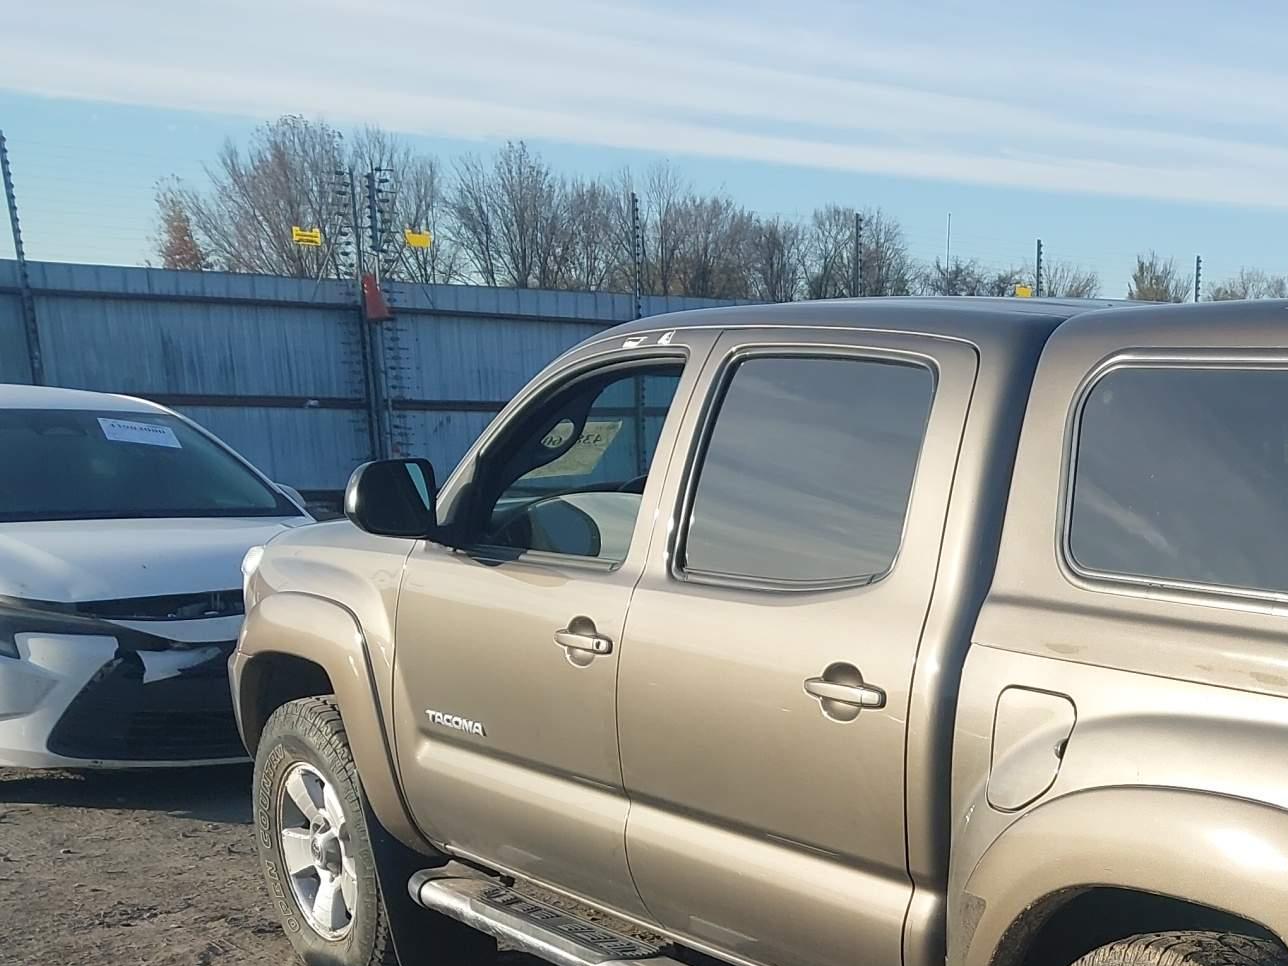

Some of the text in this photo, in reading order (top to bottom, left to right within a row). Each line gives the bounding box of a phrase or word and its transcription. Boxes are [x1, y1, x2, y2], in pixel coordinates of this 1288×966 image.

[424, 709, 486, 737] TACOMA
[258, 743, 300, 933] OPEN COUNTRY
